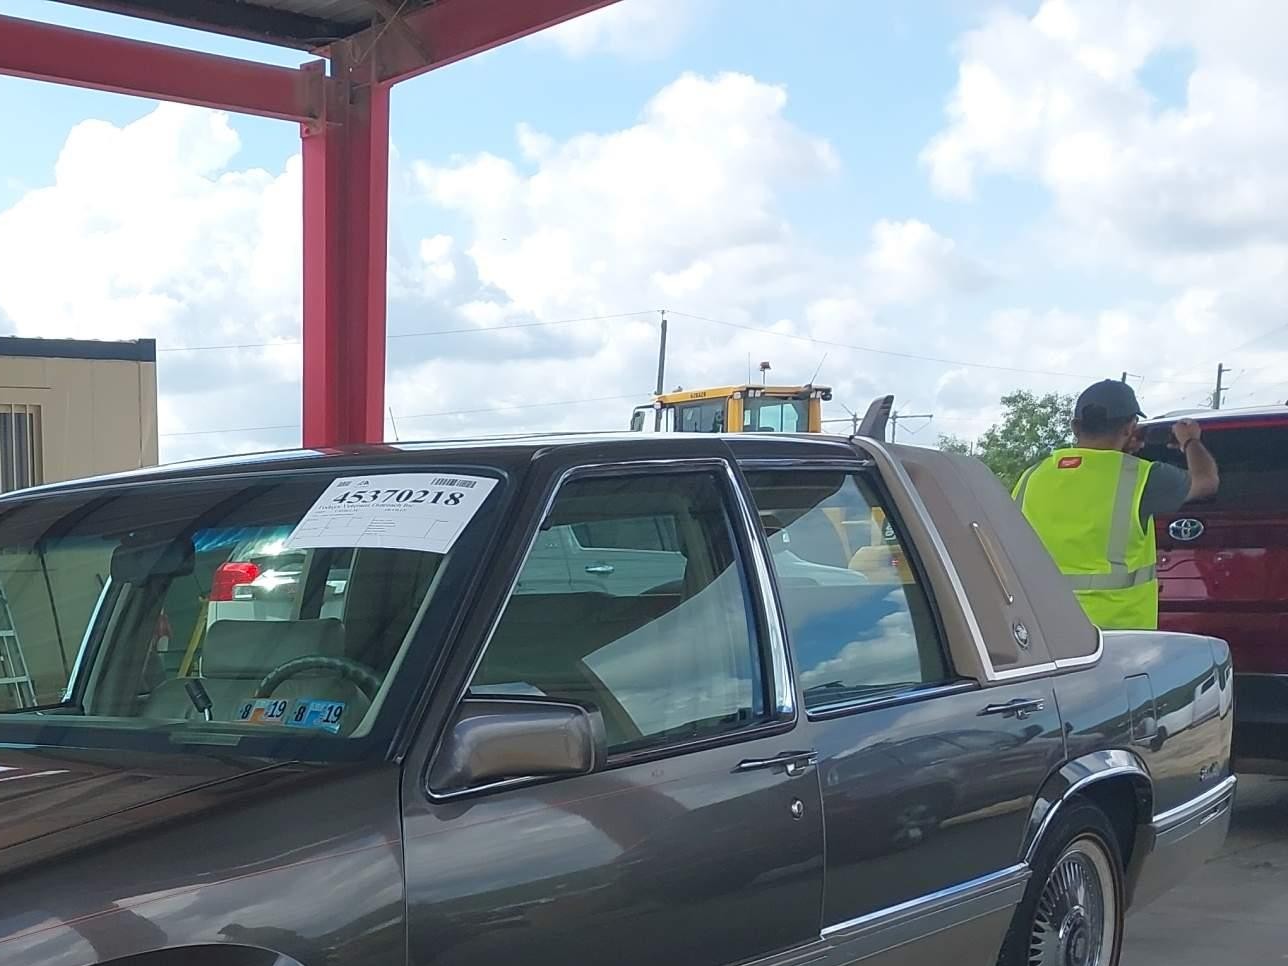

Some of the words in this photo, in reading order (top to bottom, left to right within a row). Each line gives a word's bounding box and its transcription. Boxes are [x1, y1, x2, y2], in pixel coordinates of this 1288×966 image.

[333, 488, 466, 506] 45370218
[241, 703, 253, 719] 8
[268, 700, 288, 718] 19
[295, 705, 307, 722] 8
[322, 705, 344, 724] 19
